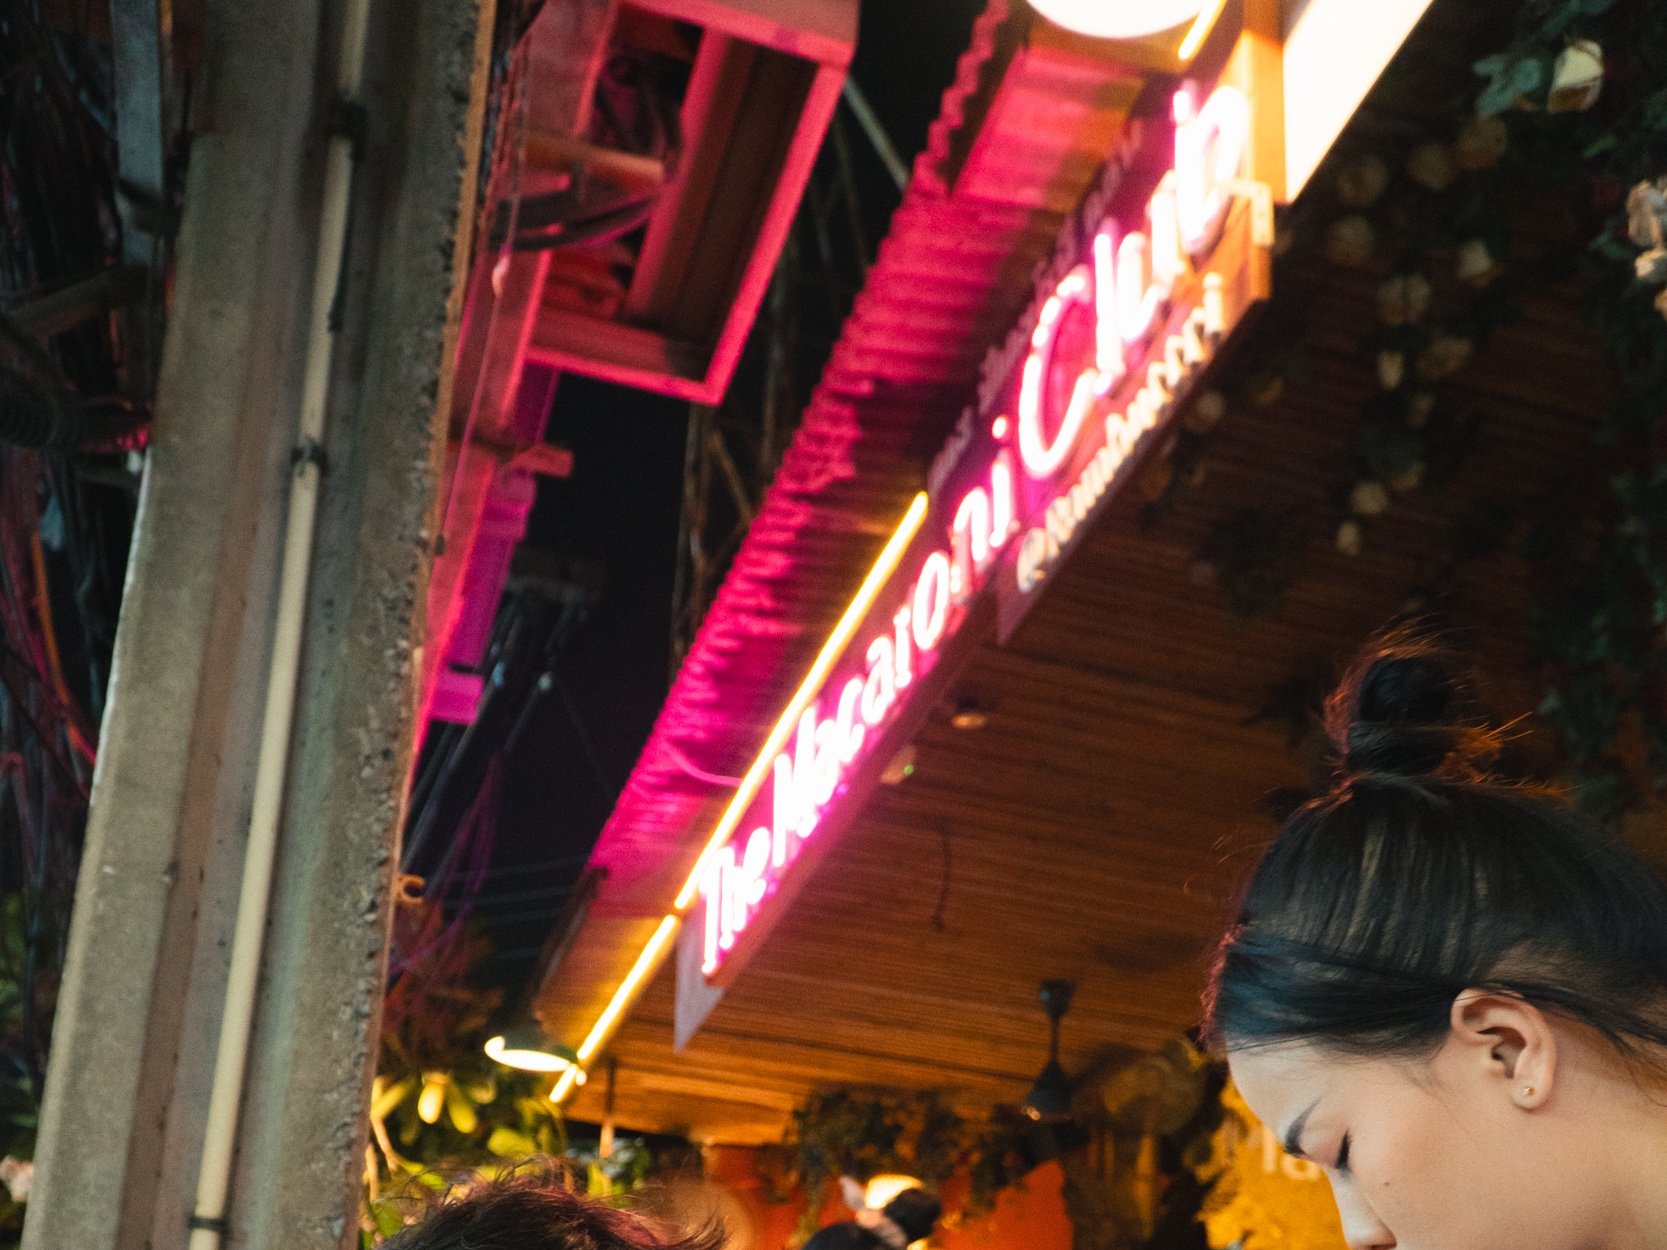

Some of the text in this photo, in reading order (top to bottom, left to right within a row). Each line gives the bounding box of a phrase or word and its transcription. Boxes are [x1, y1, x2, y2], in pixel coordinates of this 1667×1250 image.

[700, 86, 1250, 974] The Macaroni Club
